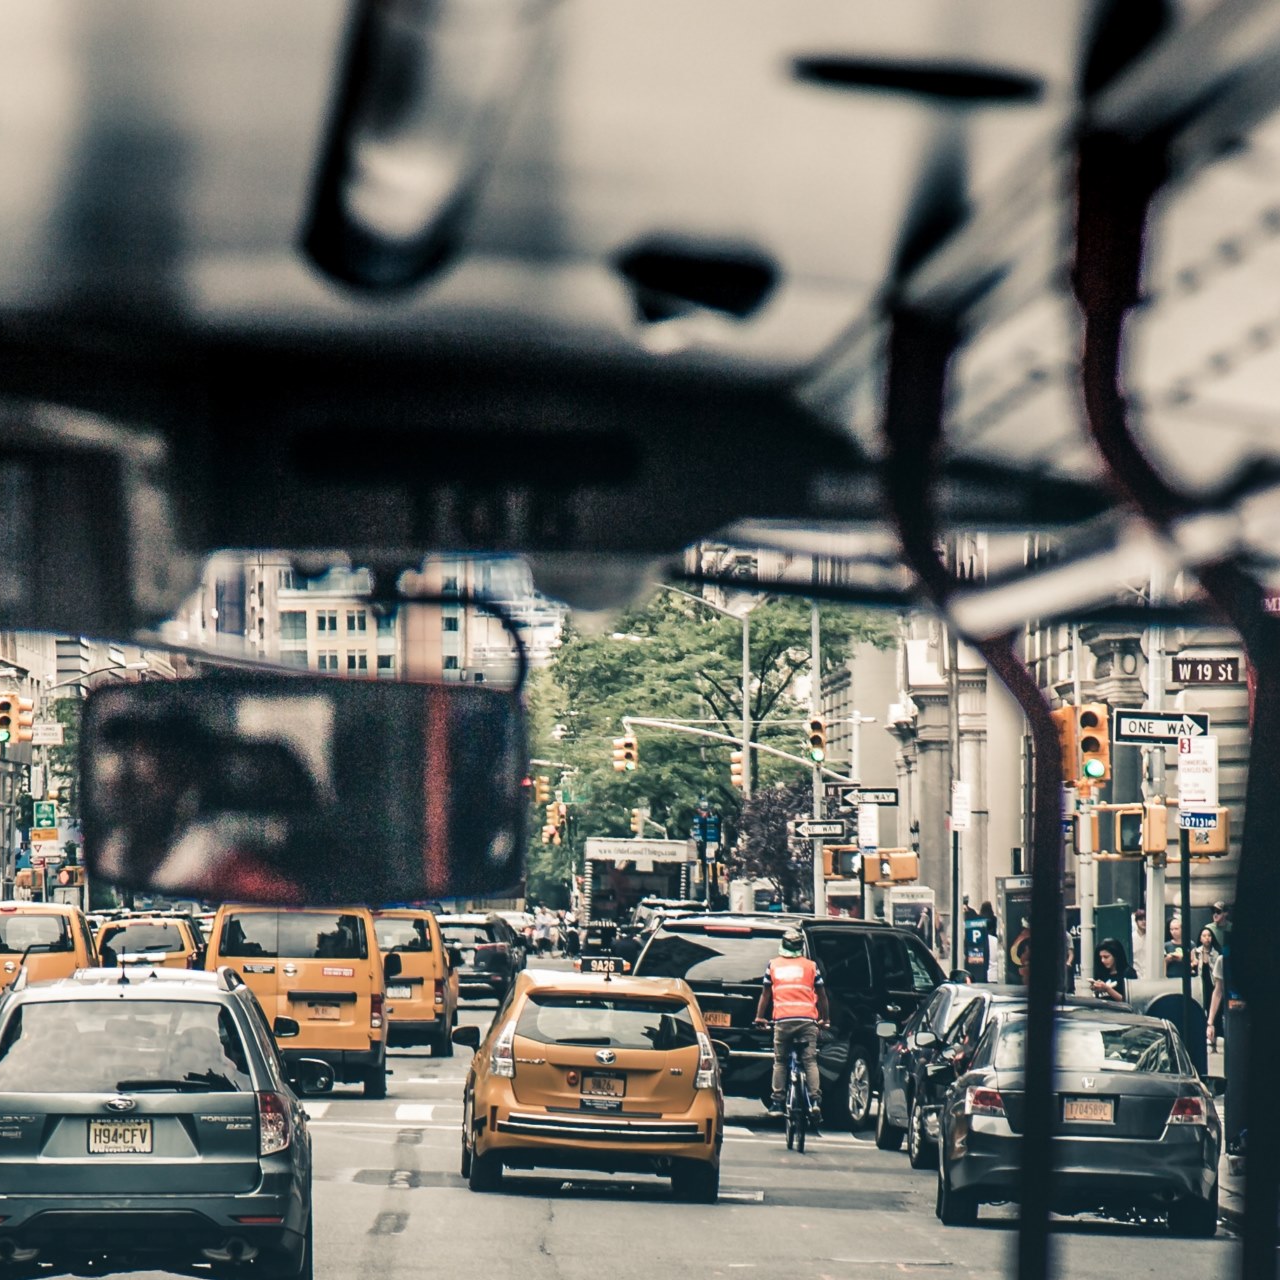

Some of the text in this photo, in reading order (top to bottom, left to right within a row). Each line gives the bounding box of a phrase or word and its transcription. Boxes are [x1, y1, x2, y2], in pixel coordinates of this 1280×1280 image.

[1179, 664, 1233, 680] W 19 St
[1128, 720, 1194, 735] ONE WAY
[1181, 739, 1190, 753] 3
[874, 793, 892, 801] WAY
[823, 825, 837, 833] WAY
[972, 930, 982, 943] P
[591, 960, 615, 972] 9A26
